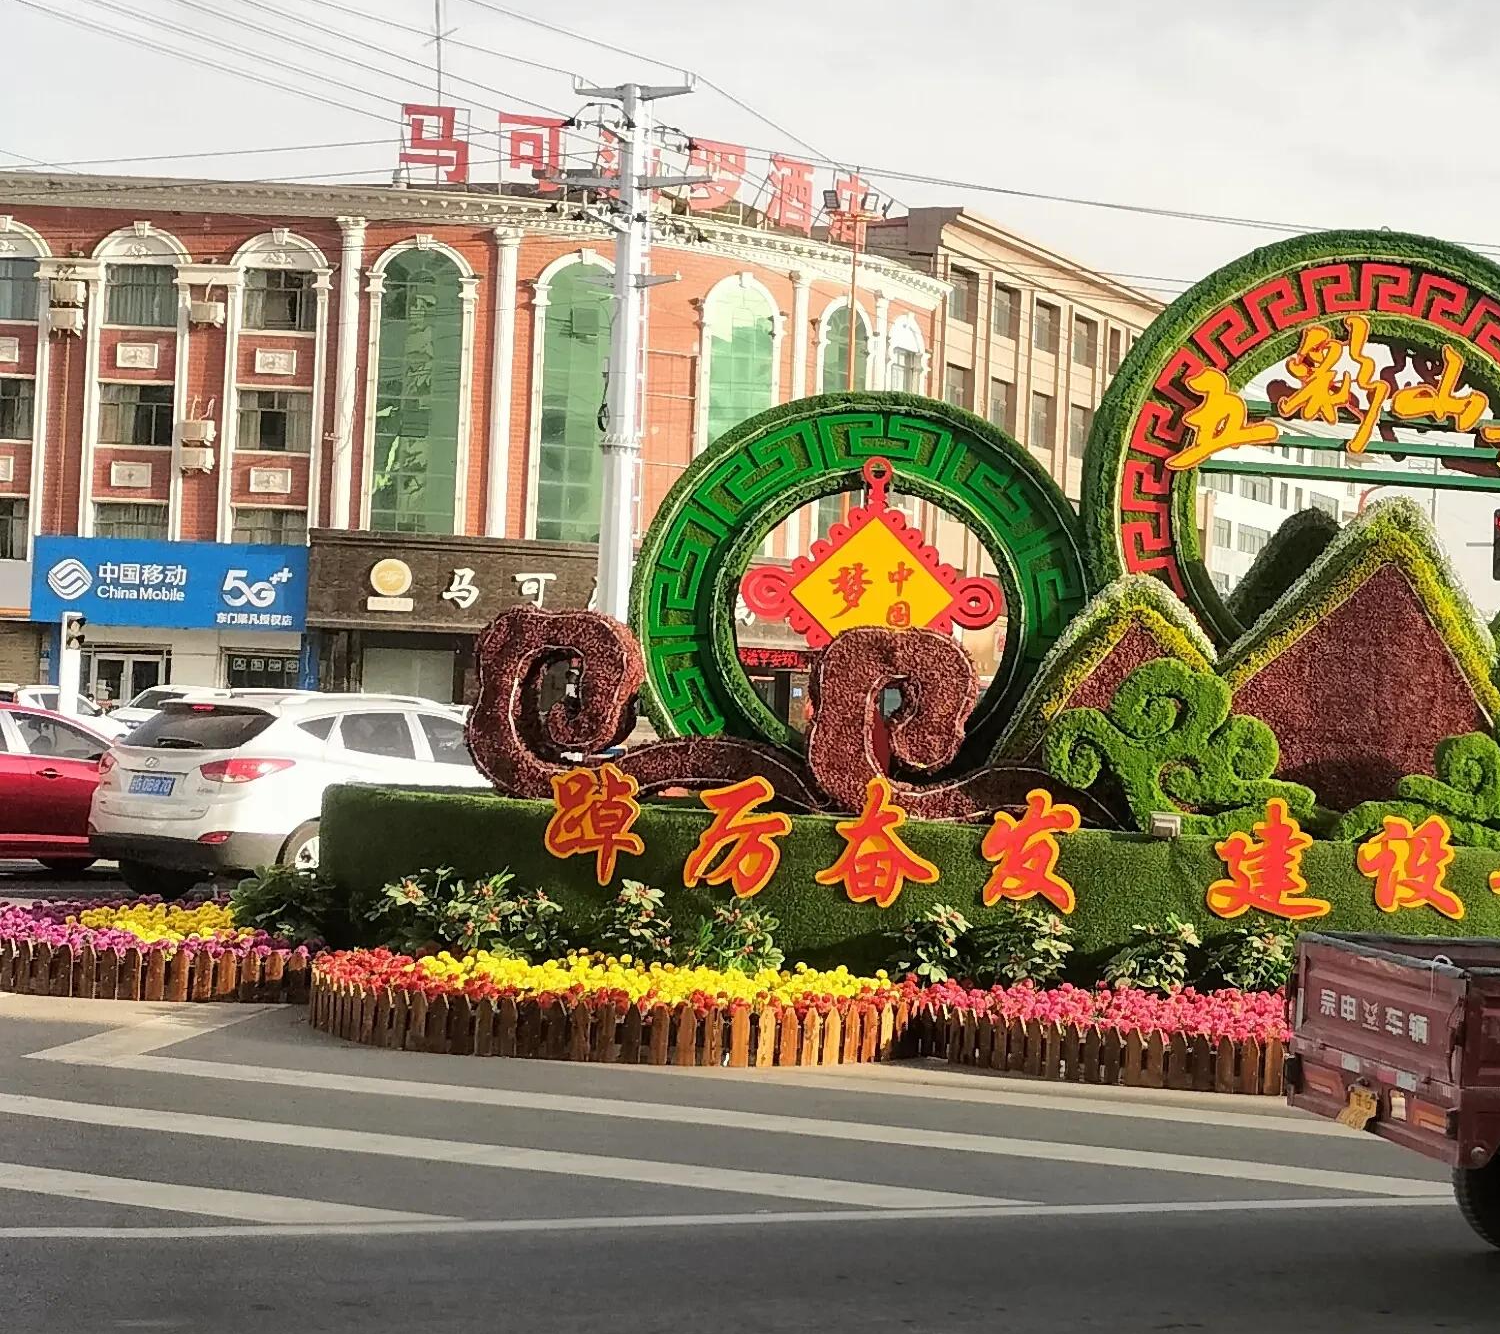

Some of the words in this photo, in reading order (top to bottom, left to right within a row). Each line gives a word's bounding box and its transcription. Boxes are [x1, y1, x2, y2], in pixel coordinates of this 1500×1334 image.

[98, 562, 188, 587] 中国移动
[97, 585, 138, 600] China
[139, 586, 186, 602] Mobile
[544, 763, 1081, 914] 踔厉奋发
